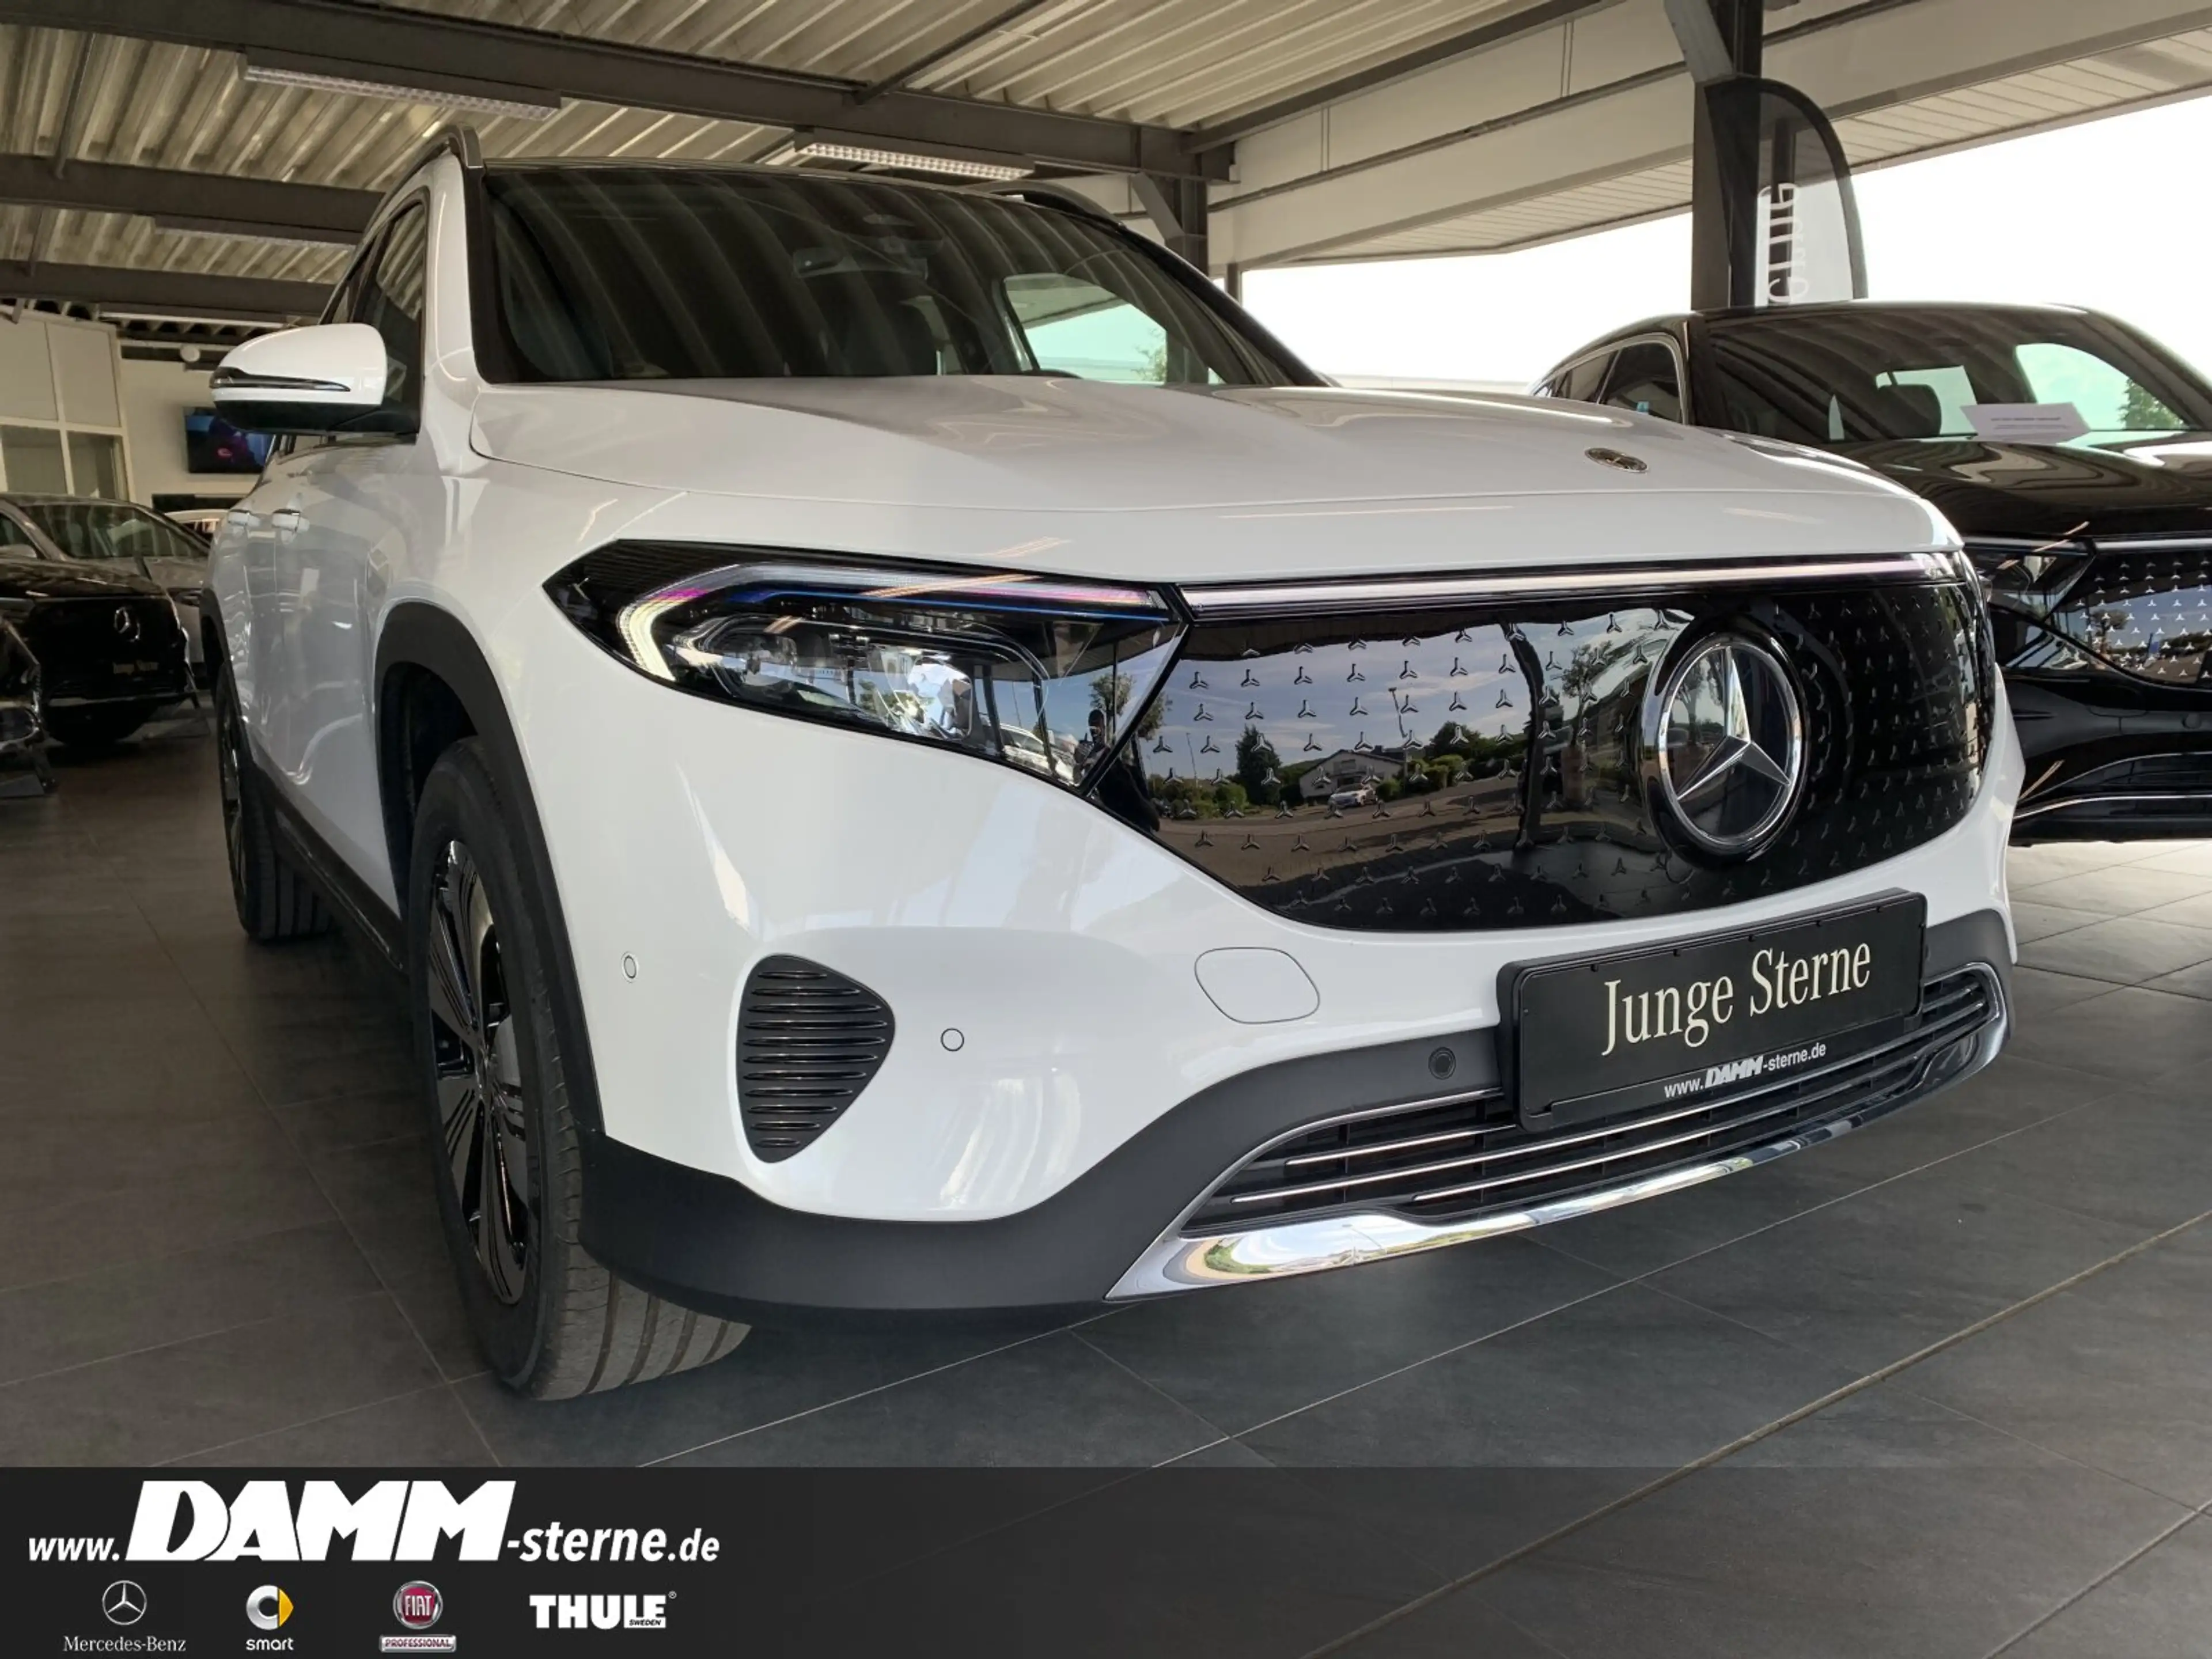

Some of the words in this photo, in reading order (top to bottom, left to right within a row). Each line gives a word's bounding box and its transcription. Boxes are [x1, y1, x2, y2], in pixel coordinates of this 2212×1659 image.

[1601, 976, 1733, 1056] Junge
[1750, 943, 1870, 1017] Sterne
[1664, 1042, 1826, 1098] www.DAMM-sterne.de
